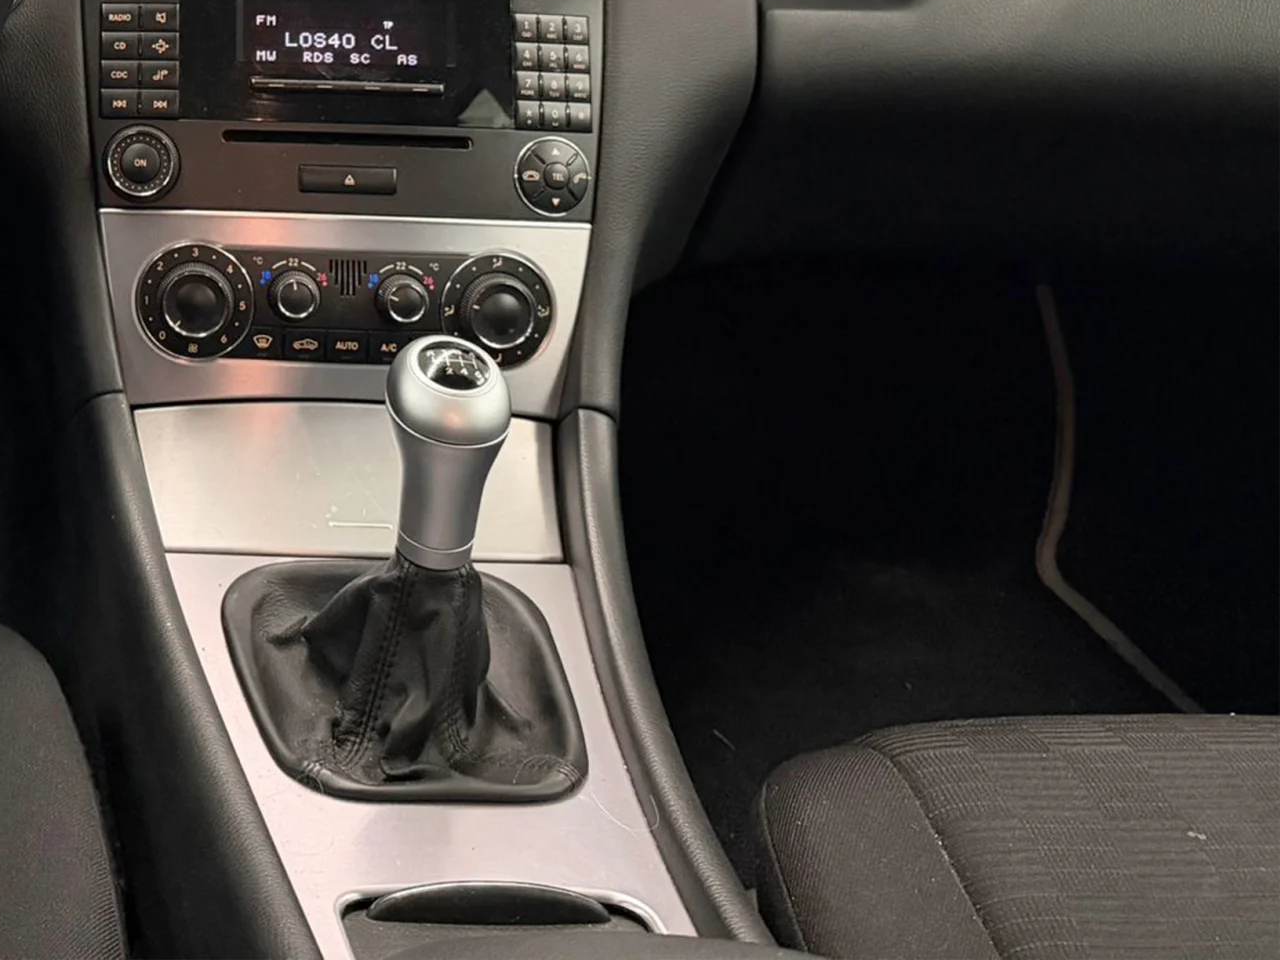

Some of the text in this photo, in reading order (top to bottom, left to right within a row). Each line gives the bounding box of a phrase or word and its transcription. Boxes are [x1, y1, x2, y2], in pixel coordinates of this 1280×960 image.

[109, 13, 131, 22] RADIO
[256, 15, 277, 26] FM
[114, 42, 126, 50] CD
[285, 32, 398, 50] LOS40 CL
[256, 50, 418, 66] MW RDS SC AS
[110, 70, 128, 79] CDC
[134, 158, 147, 168] ON
[552, 173, 564, 182] TEL
[192, 247, 200, 258] 3
[156, 261, 164, 271] 2
[288, 257, 299, 267] 22
[395, 261, 406, 271] 22
[226, 264, 234, 274] 4
[239, 300, 246, 311] 5
[158, 330, 167, 340] 0
[220, 334, 228, 344] 6
[335, 341, 359, 351] AUTO
[381, 343, 398, 352] A/C
